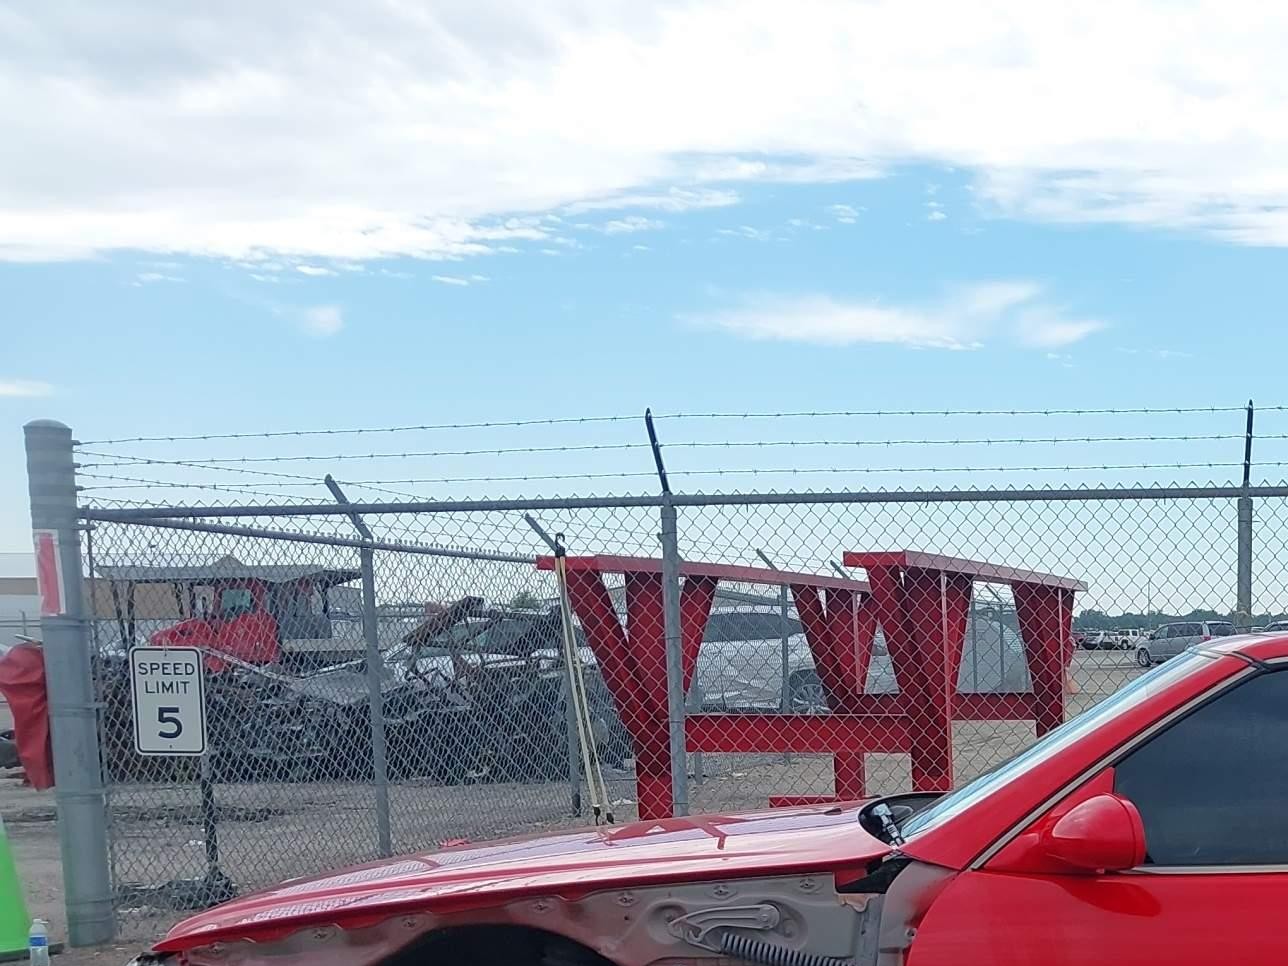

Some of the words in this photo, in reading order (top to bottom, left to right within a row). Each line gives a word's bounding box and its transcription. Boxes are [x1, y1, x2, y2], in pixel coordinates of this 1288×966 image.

[138, 662, 195, 676] SPEED
[144, 681, 190, 694] LIMIT
[157, 706, 183, 739] 5
